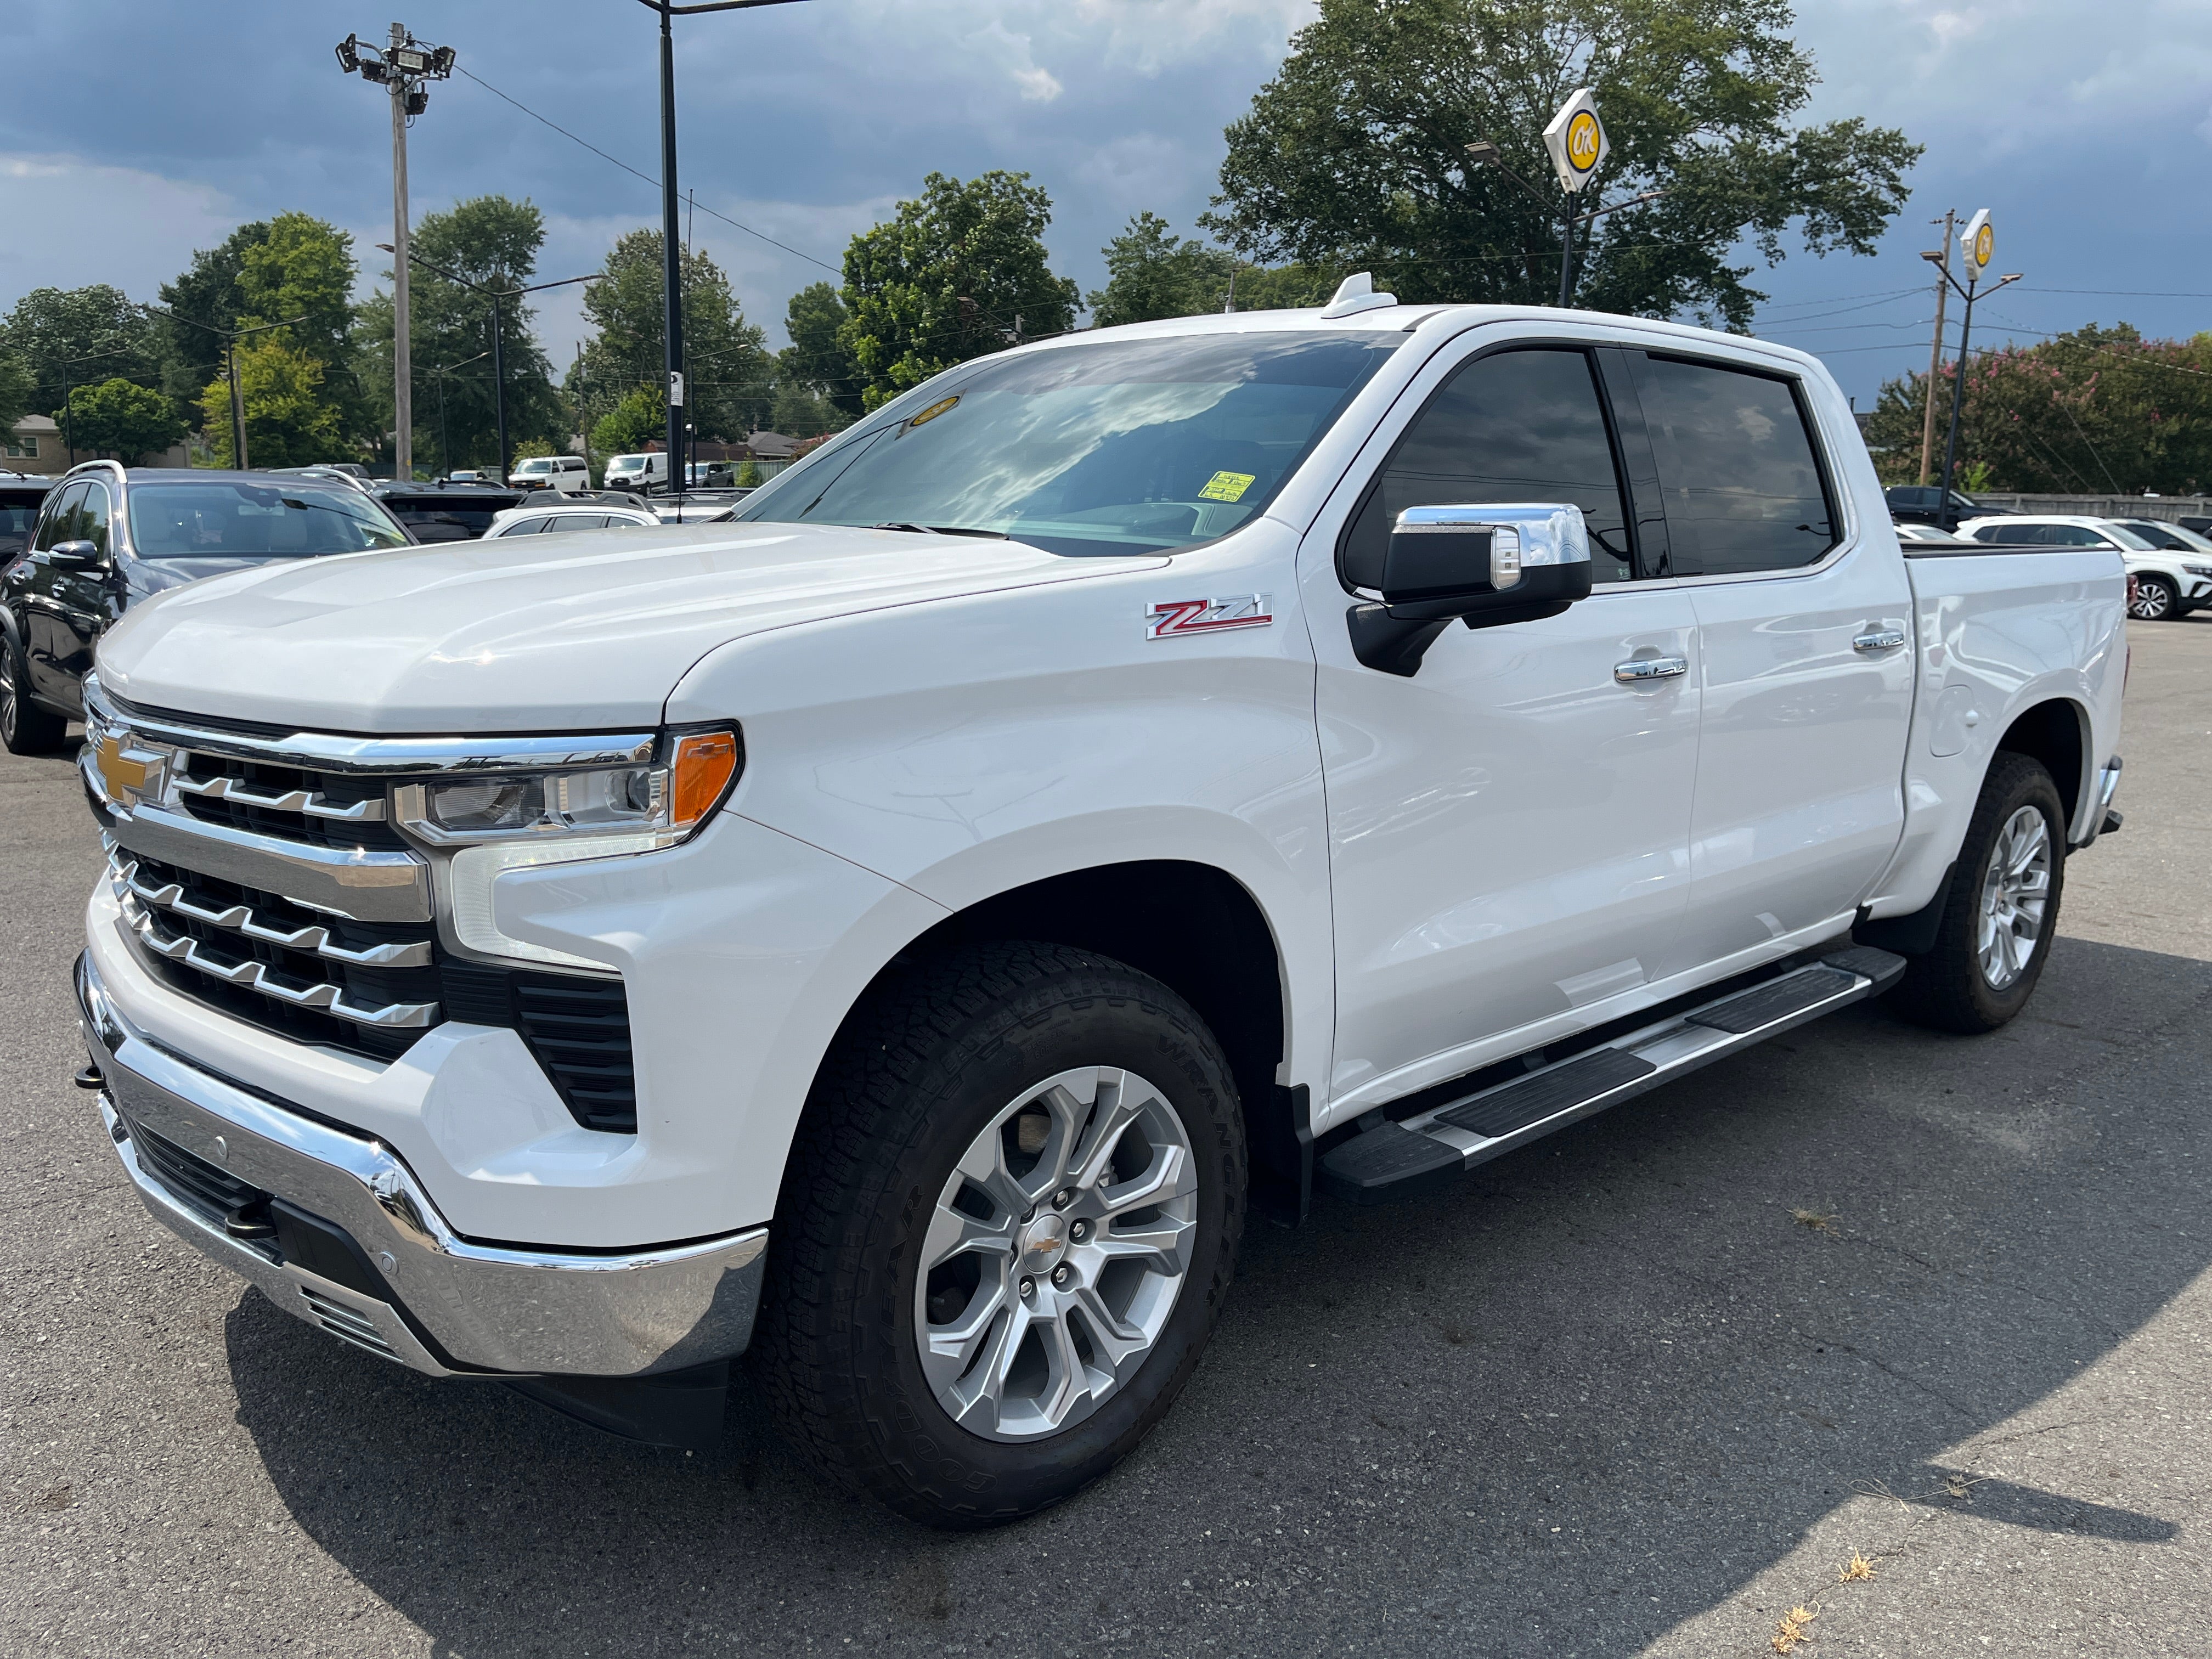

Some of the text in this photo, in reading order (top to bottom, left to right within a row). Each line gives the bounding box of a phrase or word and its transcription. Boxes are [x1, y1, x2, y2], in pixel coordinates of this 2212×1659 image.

[1572, 121, 1595, 156] OK
[1144, 592, 1274, 641] Z71
[1155, 1032, 1237, 1308] WRANGLER
[879, 1184, 998, 1494] GOODYEAR
